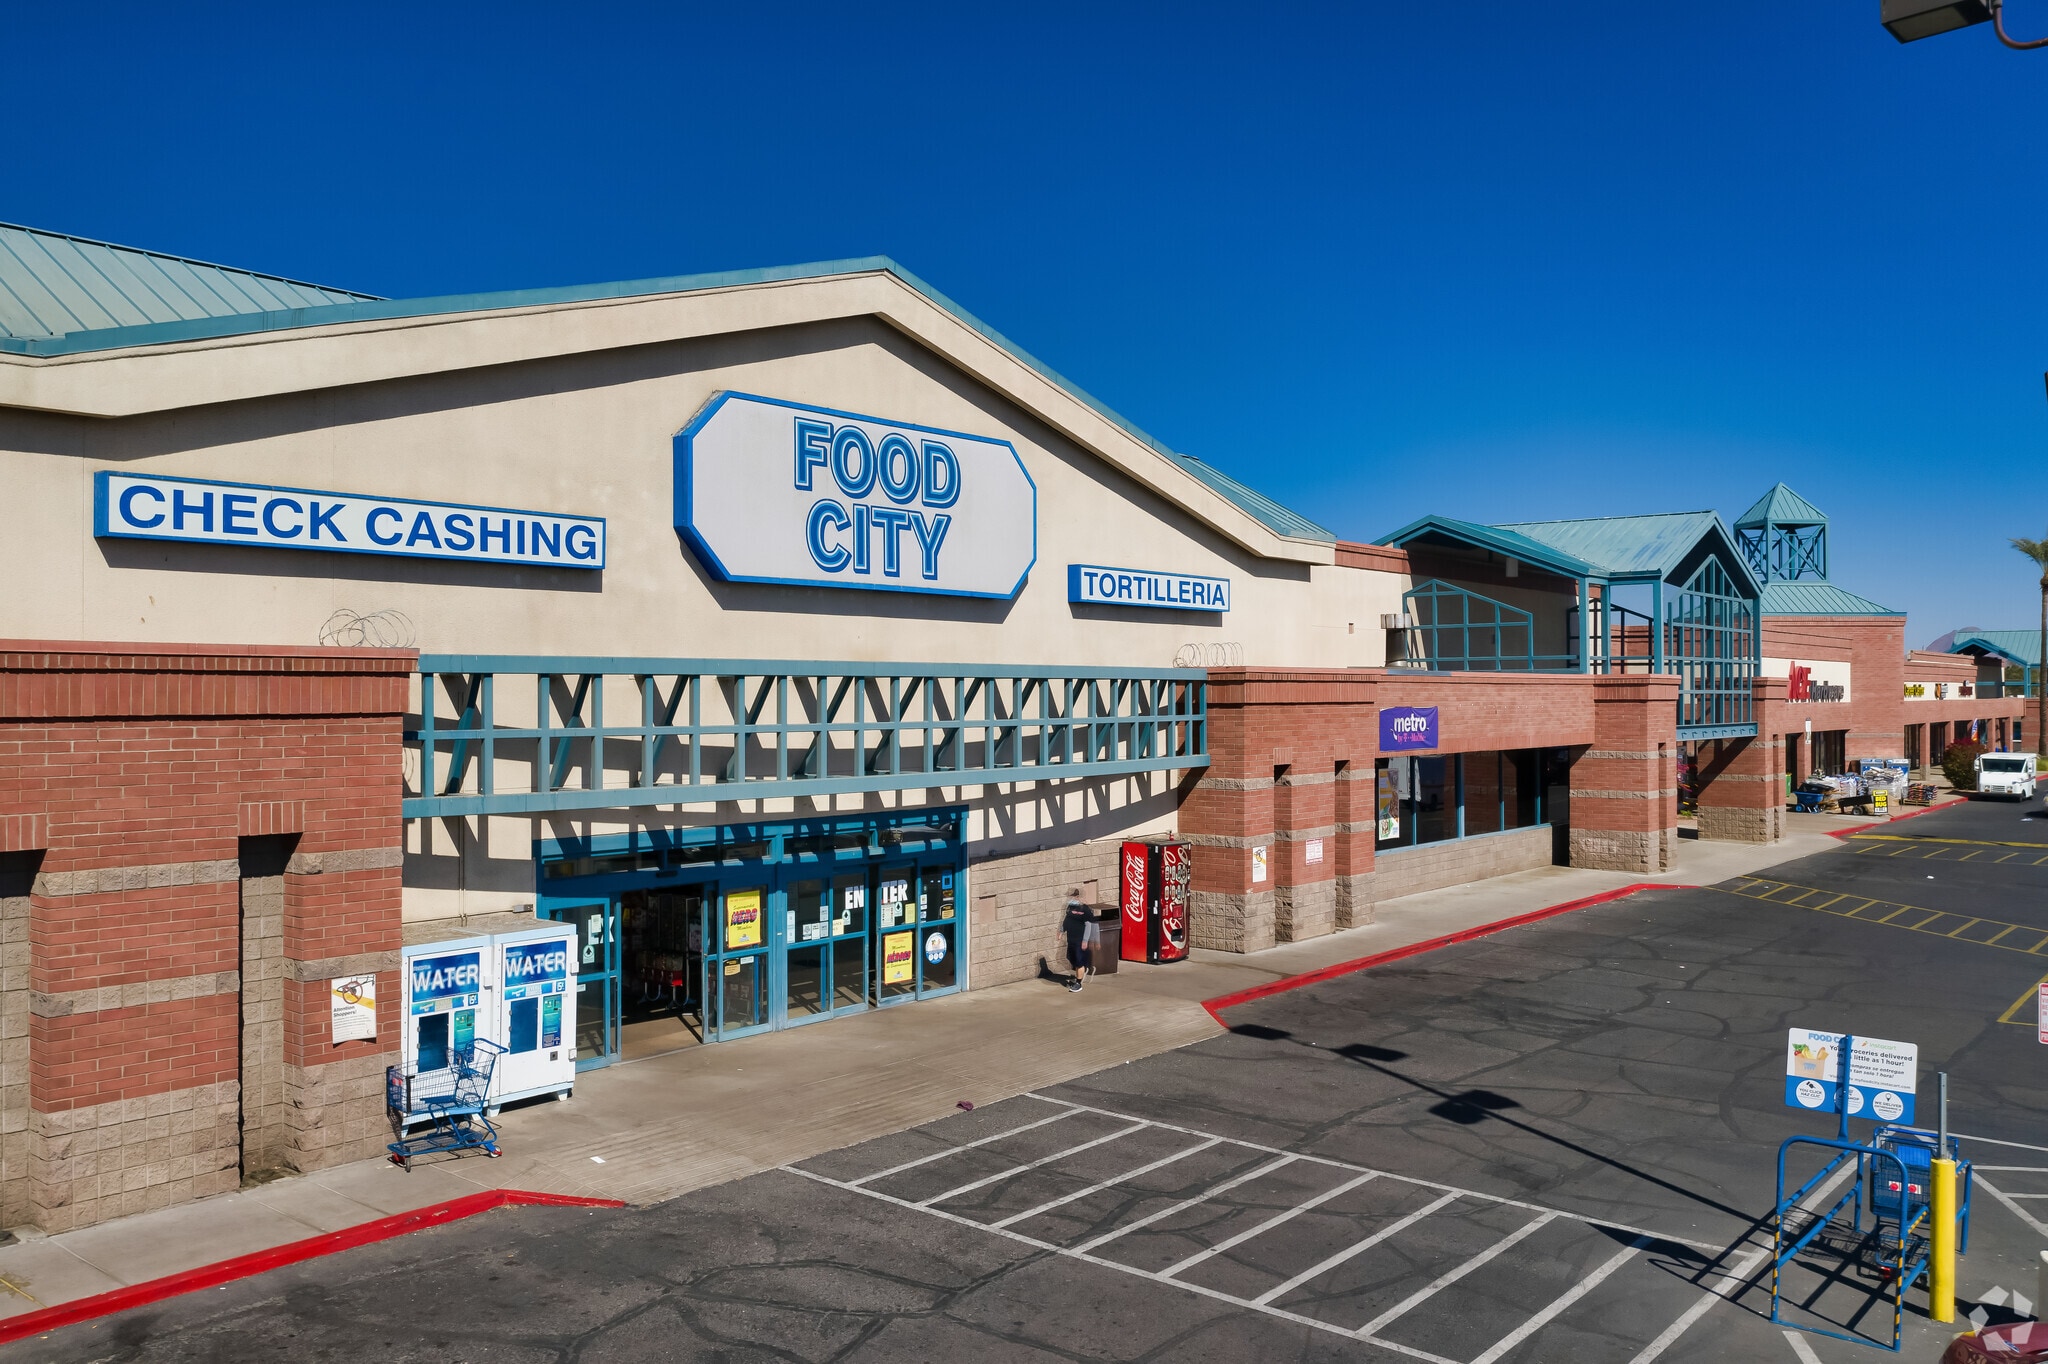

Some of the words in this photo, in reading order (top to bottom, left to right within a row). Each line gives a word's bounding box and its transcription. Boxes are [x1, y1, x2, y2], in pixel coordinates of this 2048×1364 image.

[793, 415, 962, 509] FOOD
[118, 485, 347, 542] CHECK
[365, 506, 597, 560] CASHING
[805, 499, 952, 580] CITY
[1083, 571, 1226, 606] TORTILLERIA
[1393, 713, 1427, 732] metro
[1126, 851, 1145, 922] Coca-Cola
[413, 963, 479, 993] WATER
[505, 951, 566, 978] WATER
[1808, 1032, 1832, 1042] FOOD
[1880, 1052, 1913, 1061] delivered
